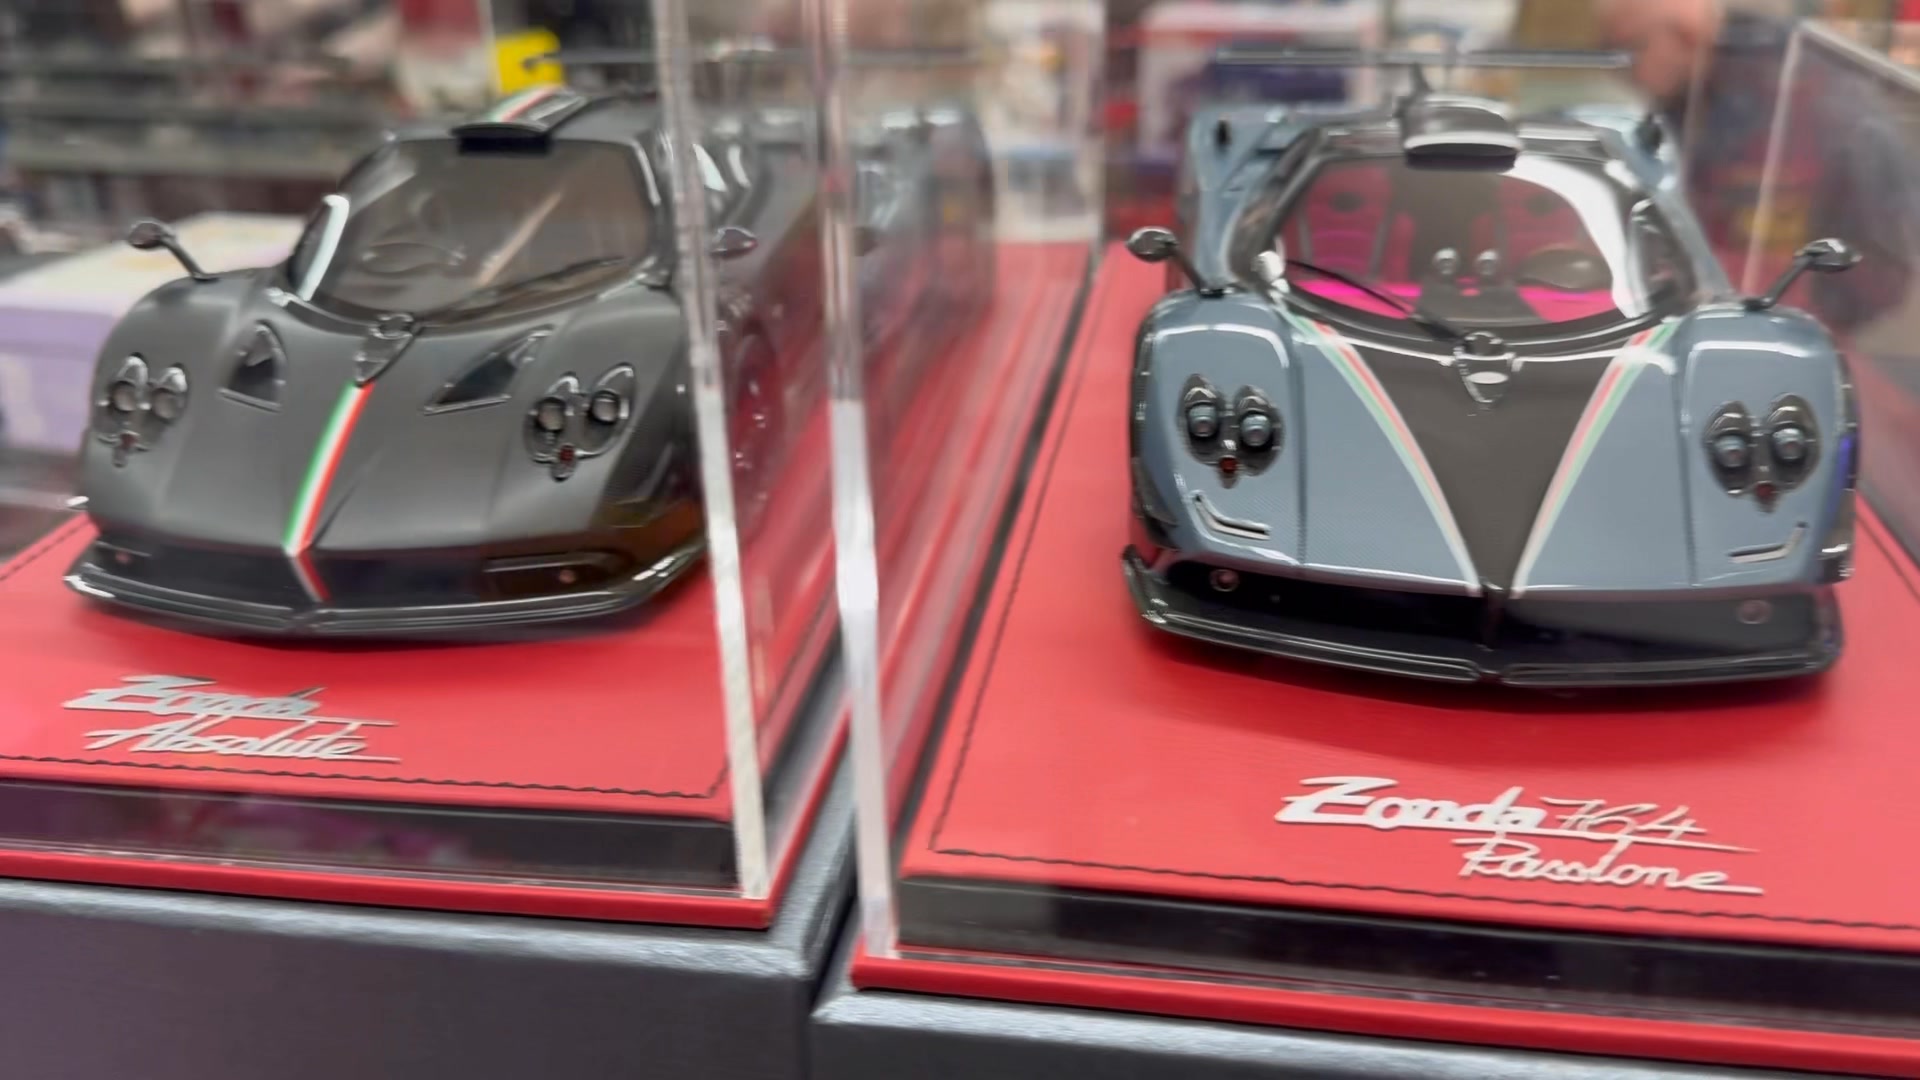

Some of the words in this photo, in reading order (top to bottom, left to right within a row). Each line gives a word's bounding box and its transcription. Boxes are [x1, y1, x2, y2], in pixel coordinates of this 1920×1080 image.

[82, 712, 400, 762] Absolute
[1274, 775, 1547, 830] Zonda
[1540, 796, 1709, 841] 764
[1450, 834, 1765, 896] Passione
